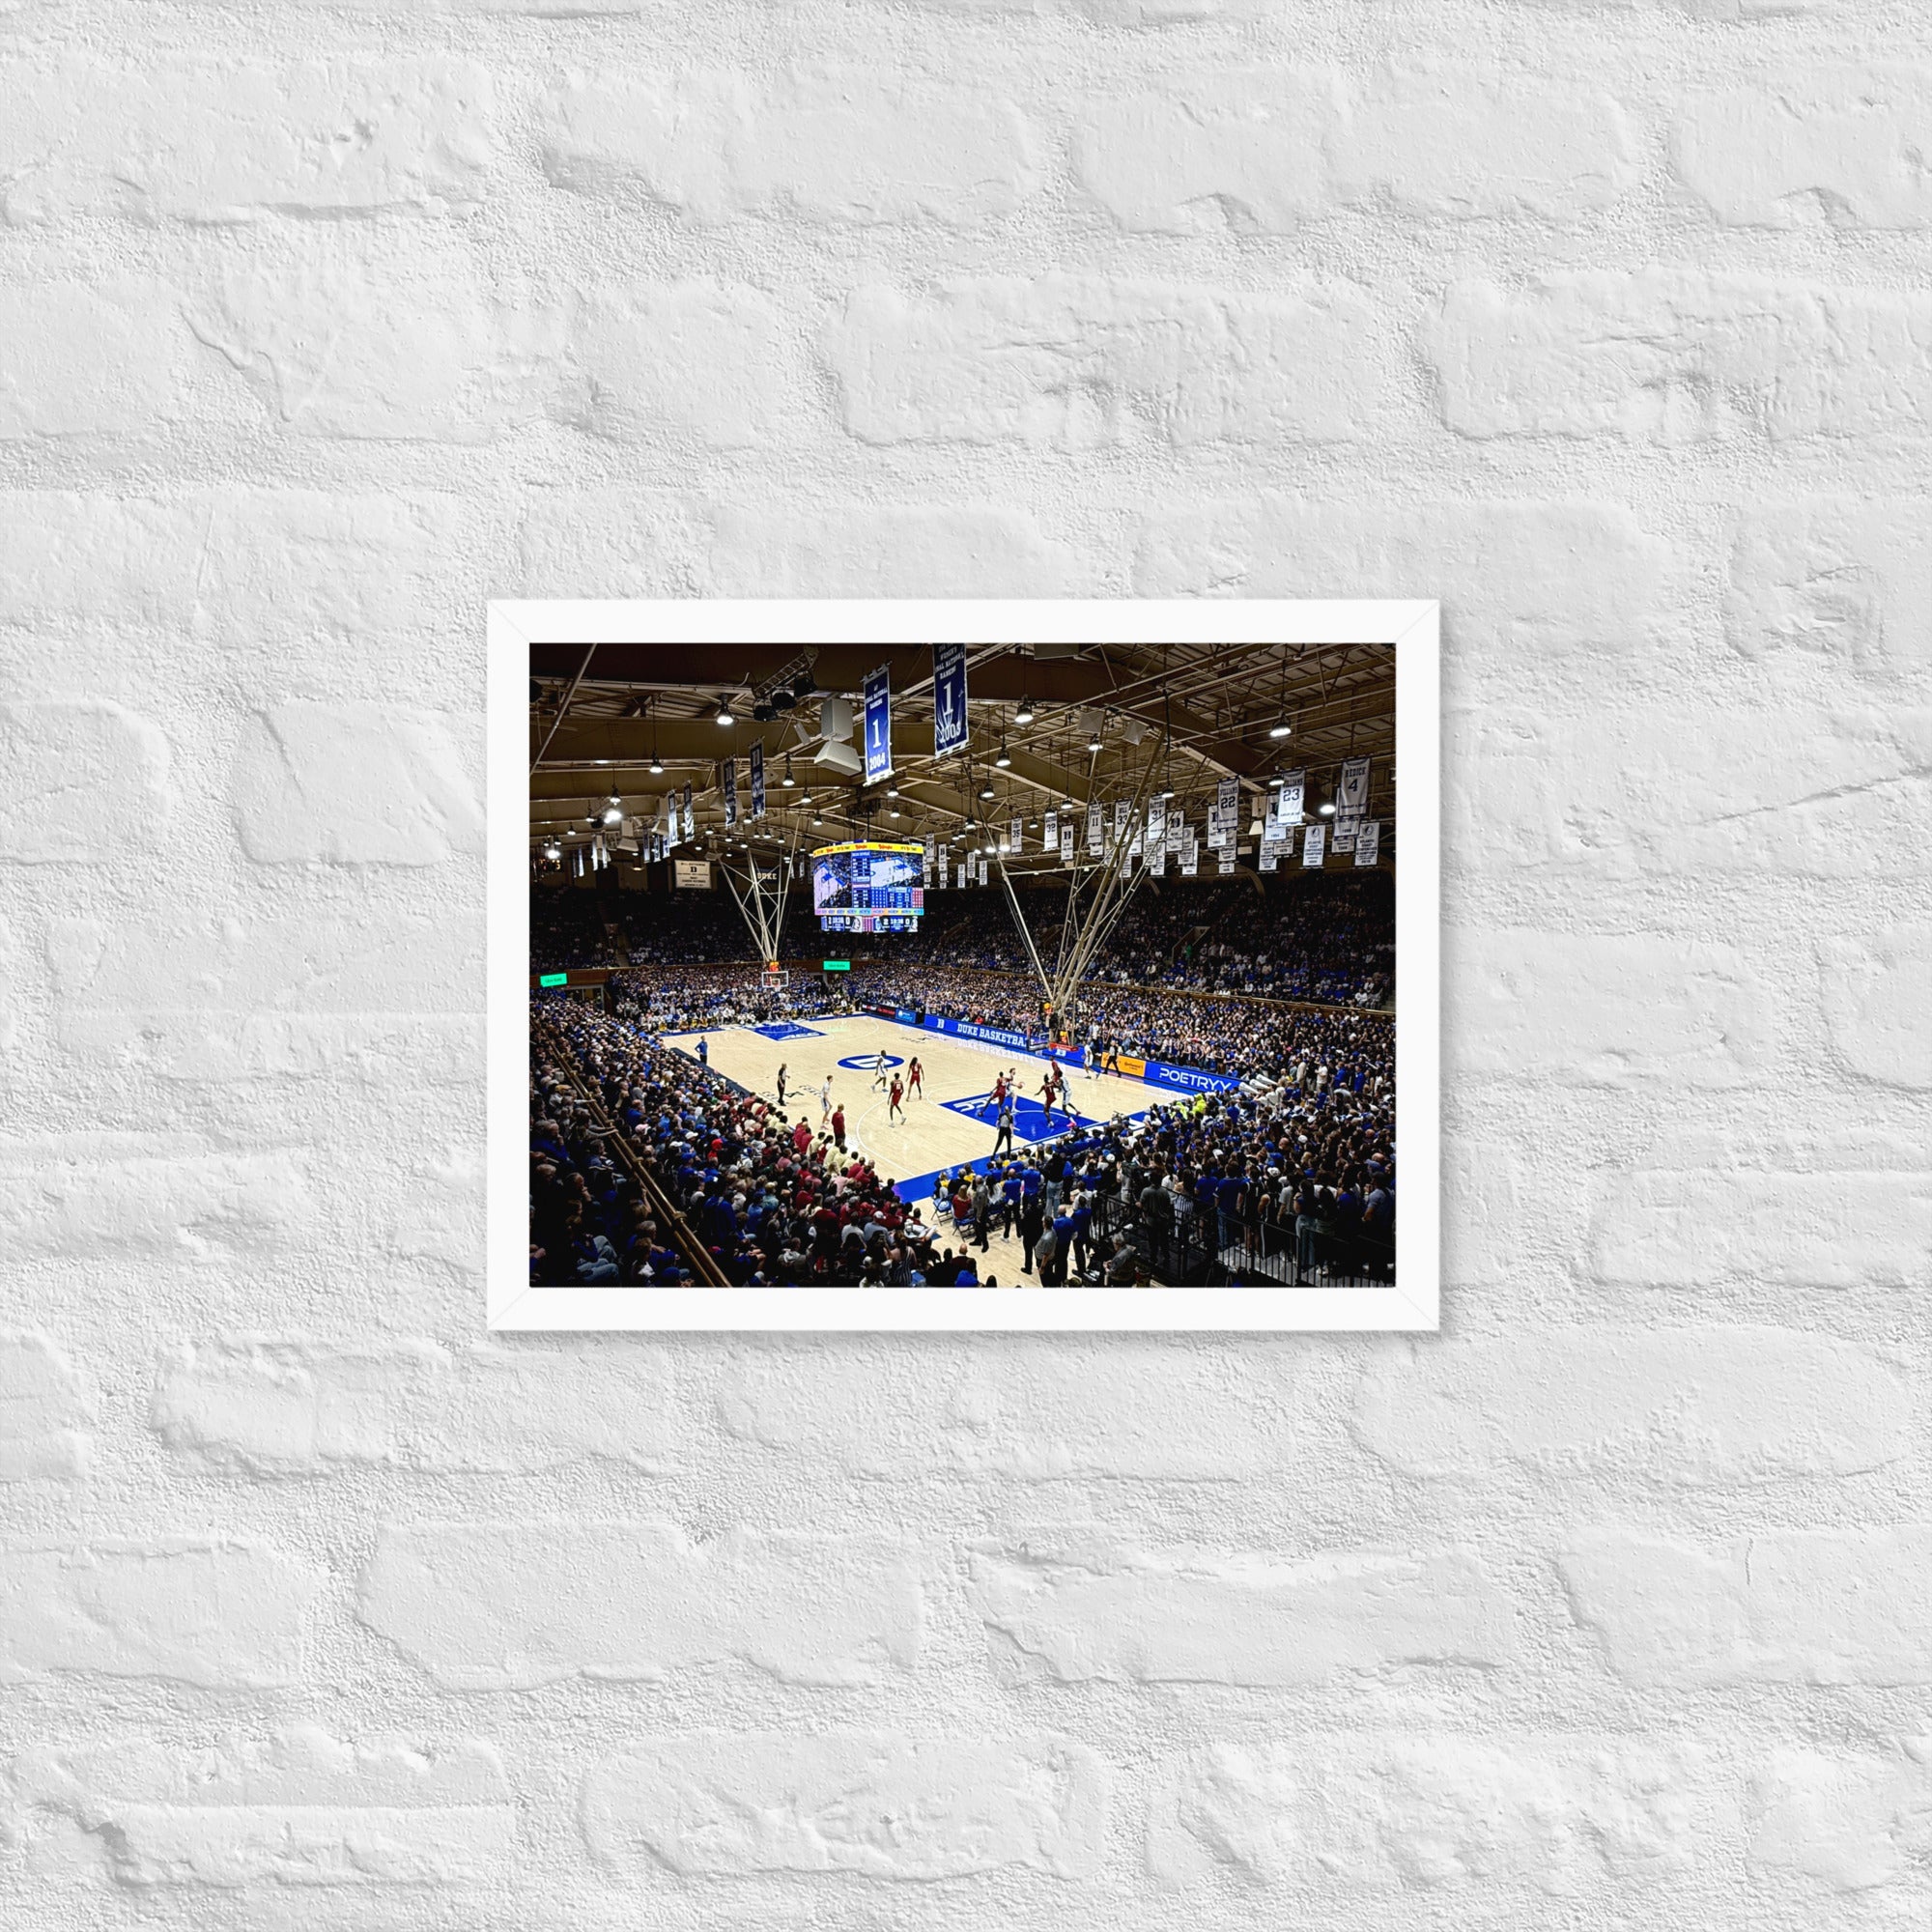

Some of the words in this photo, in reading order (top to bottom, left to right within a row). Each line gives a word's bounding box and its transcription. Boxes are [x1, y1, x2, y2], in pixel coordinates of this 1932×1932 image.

[944, 681, 953, 716] 1
[872, 719, 881, 749] 1
[869, 753, 886, 771] 2004
[1283, 788, 1300, 802] 23
[1348, 779, 1358, 792] 4
[1220, 796, 1236, 810] 22
[957, 1024, 979, 1037] DUKE
[979, 1028, 1035, 1047] BASKETBA
[1159, 1067, 1233, 1092] POETRYY
